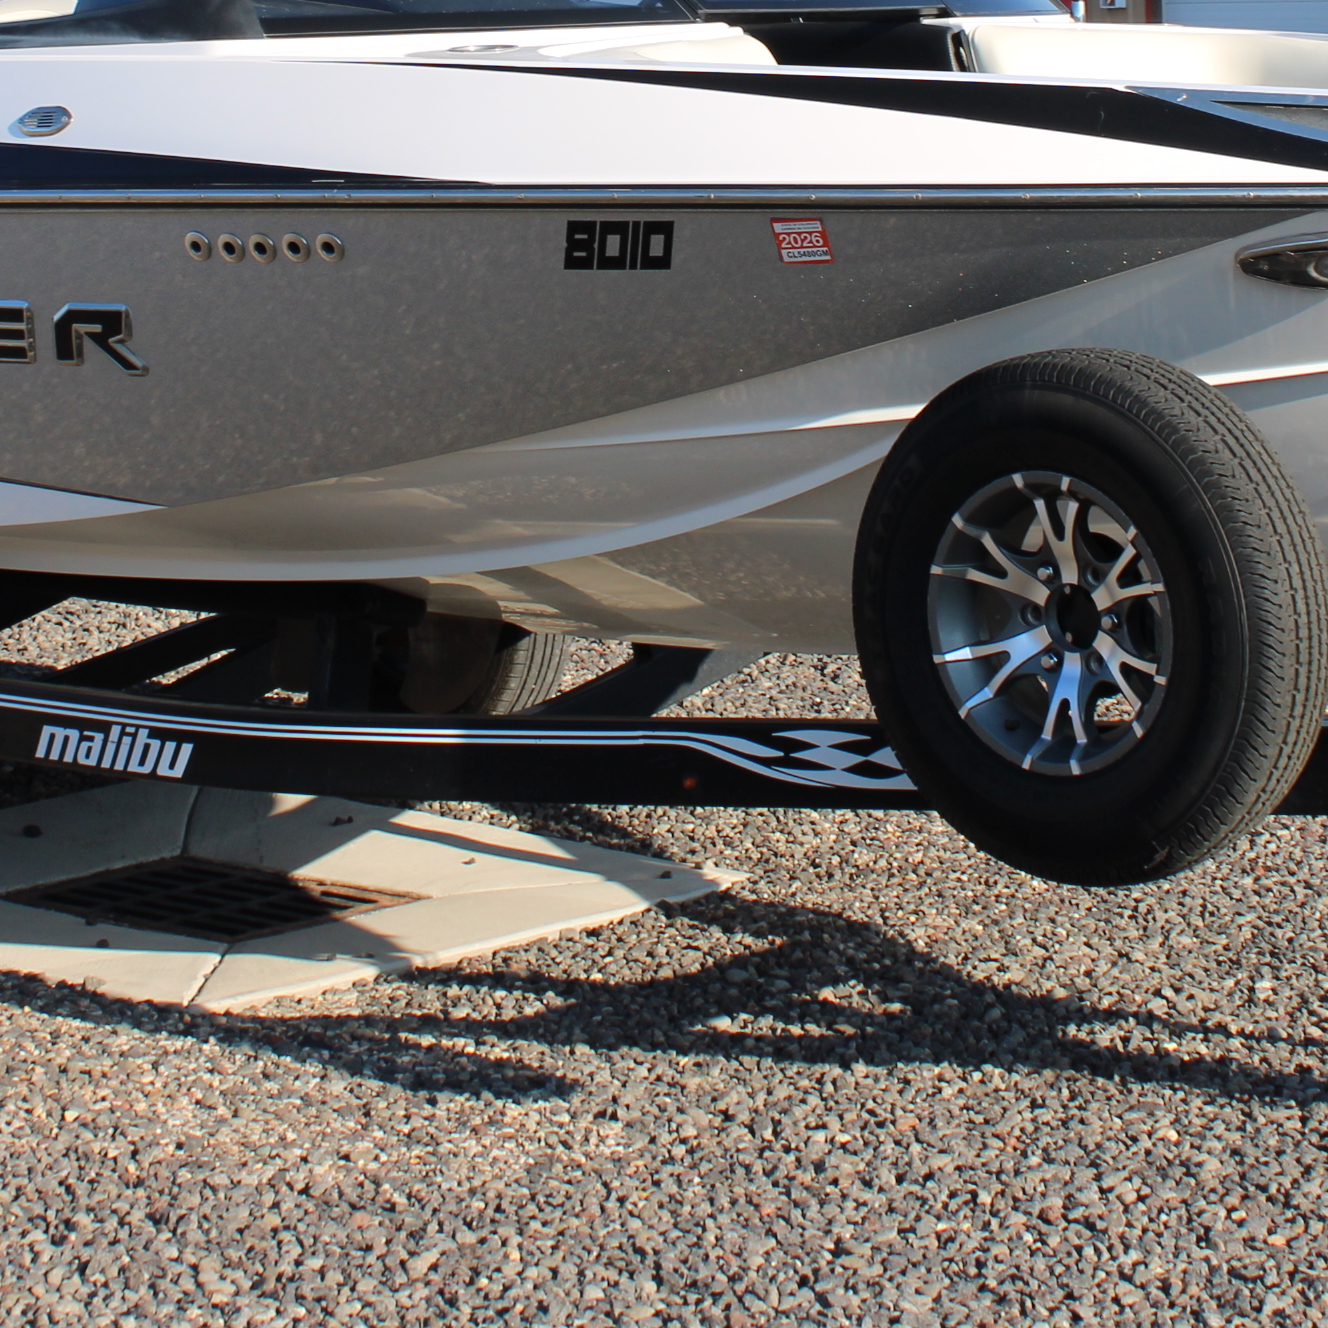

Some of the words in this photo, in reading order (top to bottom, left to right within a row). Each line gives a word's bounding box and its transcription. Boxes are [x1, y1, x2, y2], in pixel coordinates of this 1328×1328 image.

[563, 219, 675, 271] 8010
[778, 232, 824, 248] 2026
[34, 724, 195, 779] malibu
